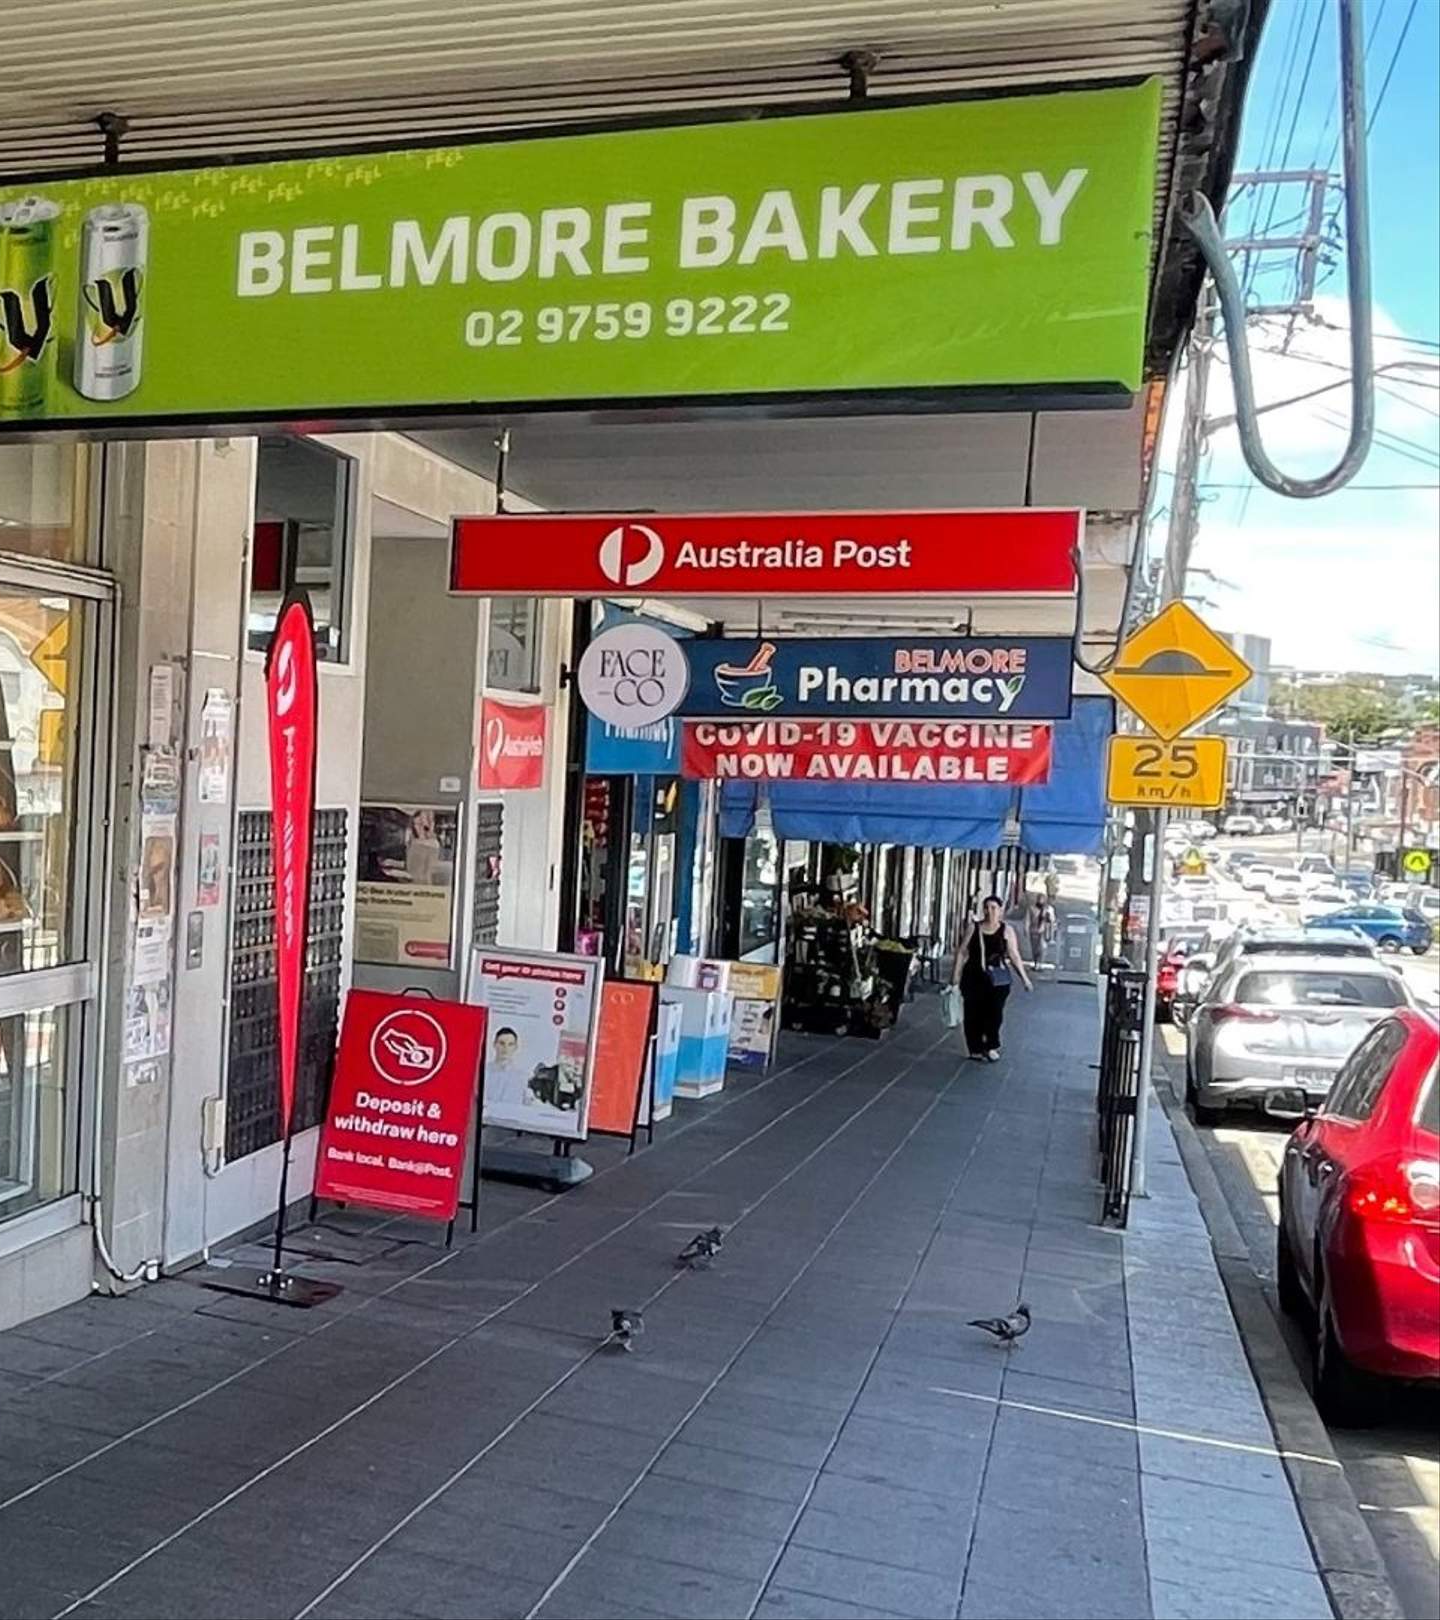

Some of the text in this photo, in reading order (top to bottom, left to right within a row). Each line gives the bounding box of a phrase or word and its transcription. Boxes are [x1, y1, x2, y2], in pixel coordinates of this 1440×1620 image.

[235, 168, 1089, 298] BELMORE BAKERY
[463, 292, 791, 348] 02 9759 9222
[674, 539, 912, 569] Australia Post
[600, 649, 666, 678] FACE
[895, 648, 1026, 674] BELMORE
[799, 667, 1025, 712] Pharmacy
[695, 721, 857, 748] COVID-19
[870, 722, 1034, 749] VACCINE
[716, 753, 1009, 781] NOW AVAILABLE
[1133, 744, 1198, 778] 25
[1137, 783, 1191, 800] km/h
[356, 1091, 441, 1119] Deposit &
[335, 1114, 458, 1147] withdraw here
[327, 1147, 355, 1163] Bank
